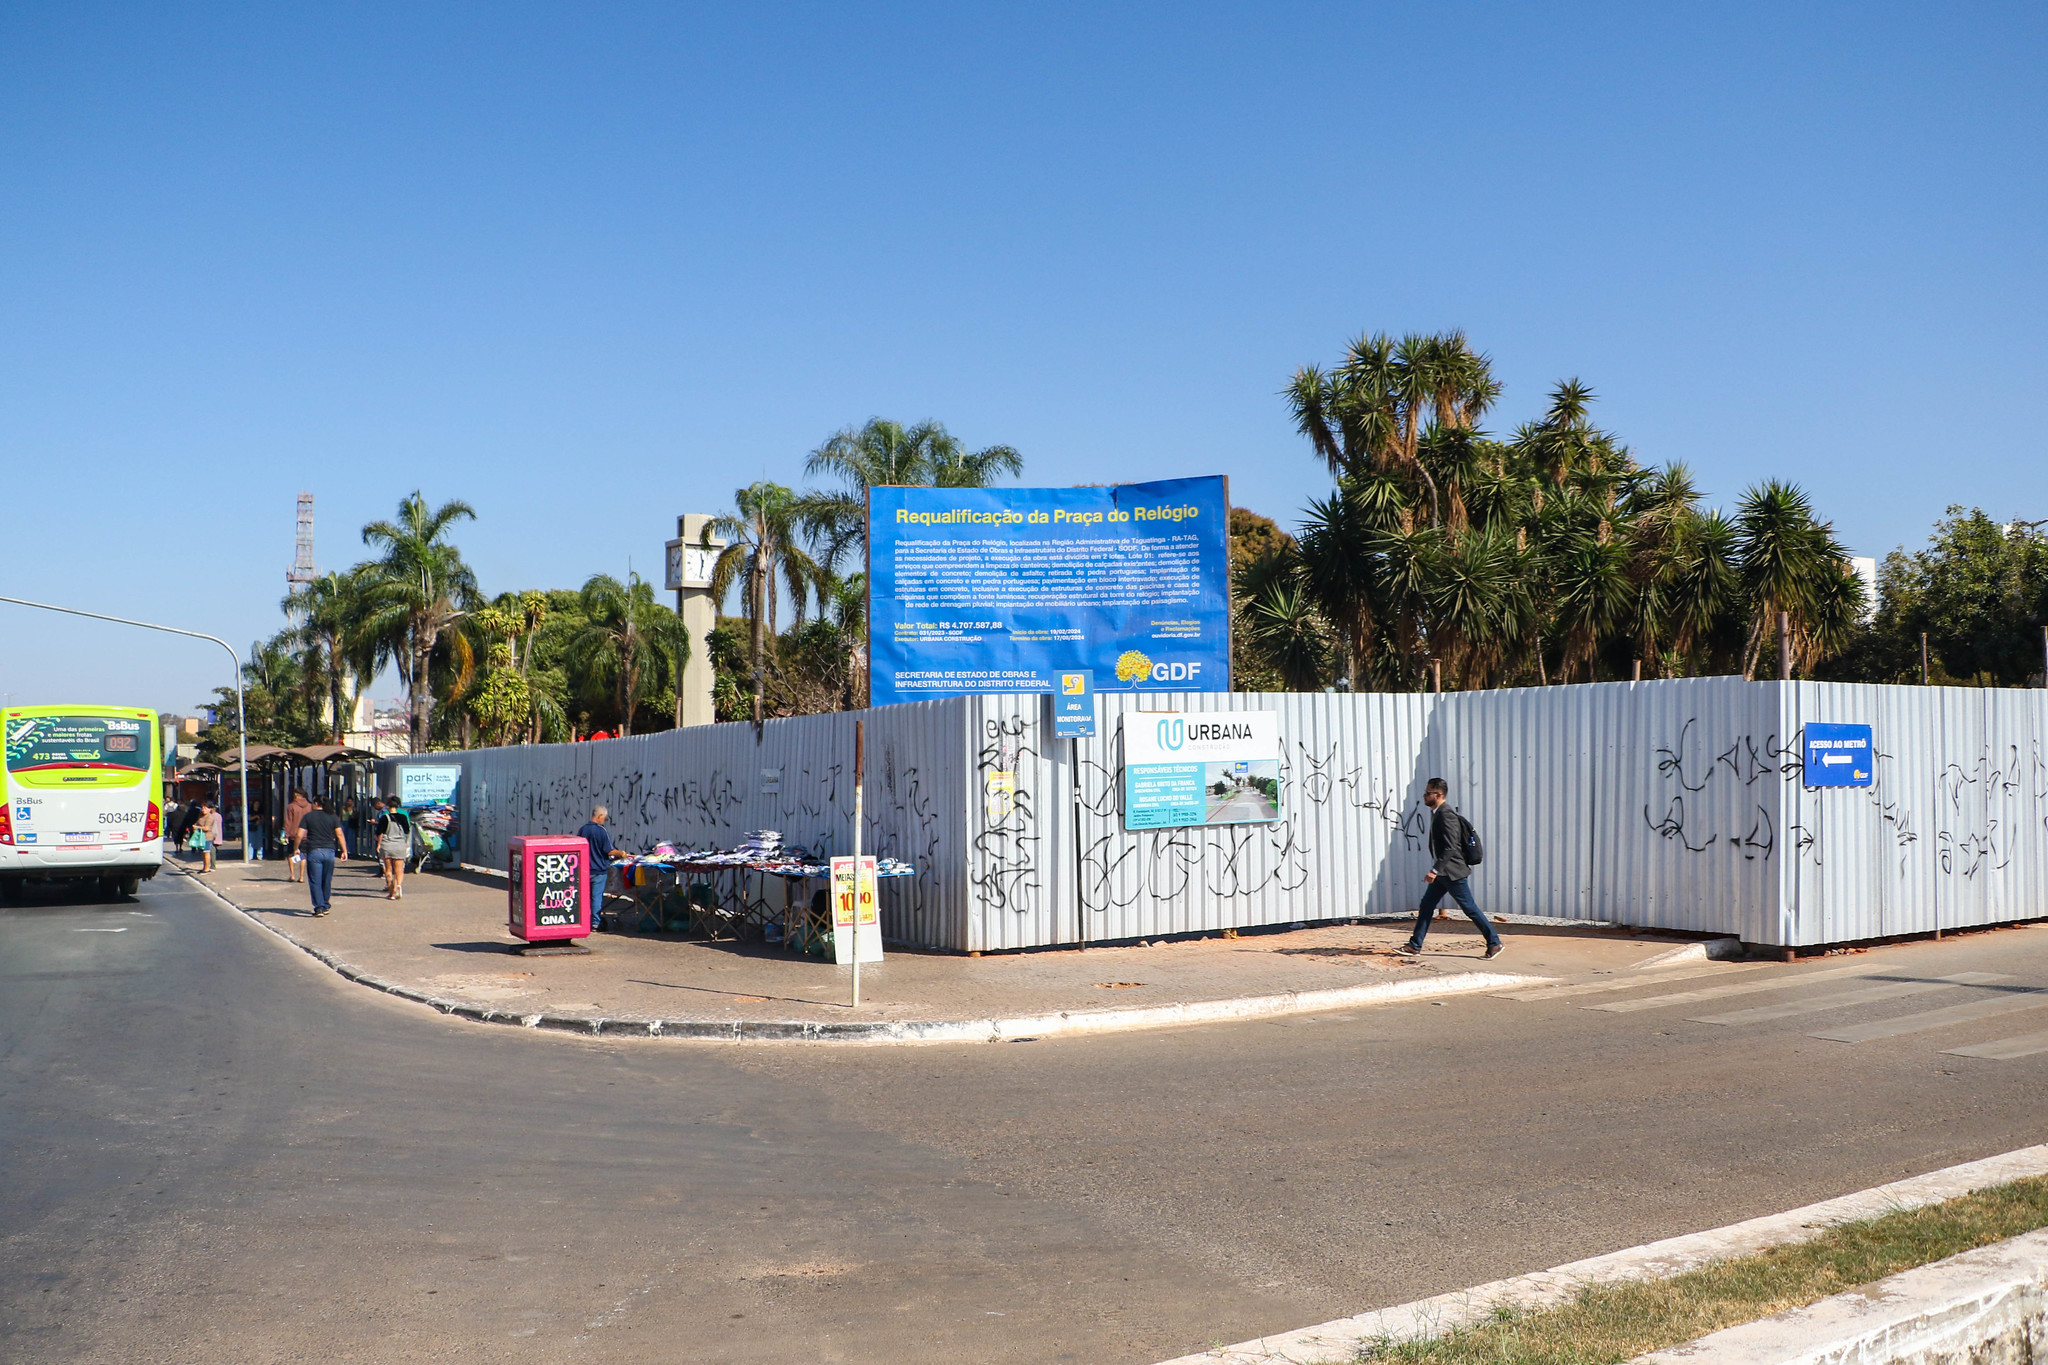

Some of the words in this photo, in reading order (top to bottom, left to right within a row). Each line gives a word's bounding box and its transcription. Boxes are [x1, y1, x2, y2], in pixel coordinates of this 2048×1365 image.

[896, 509, 1023, 527] Requalificação
[1028, 510, 1049, 524] da
[1054, 509, 1103, 527] Praça
[1108, 509, 1129, 522] do
[1134, 504, 1199, 522] Relógio
[939, 621, 950, 629] R$
[951, 621, 1003, 630] 4.707.587,88
[895, 671, 943, 679] SECRETARIA
[945, 671, 956, 679] DE
[957, 671, 988, 679] ESTADO
[1152, 662, 1201, 681] GDF
[895, 680, 963, 688] INFRAESTRUTURA
[978, 679, 1014, 687] DISTRITO
[1015, 679, 1051, 687] FEDERAL
[1066, 702, 1082, 711] ÁREA
[108, 721, 139, 730] BsBus
[1188, 723, 1253, 741] URBANA
[1809, 740, 1832, 749] ACESSO
[1833, 740, 1843, 748] AO
[1843, 738, 1866, 748] METRÔ
[1133, 765, 1172, 775] RESPONSÁVEIS
[1173, 764, 1198, 773] TÉCNICOS
[406, 772, 433, 784] park
[16, 797, 43, 805] BsBus
[98, 812, 145, 824] 503487
[537, 871, 570, 884] SHOP
[541, 915, 566, 925] QNA
[569, 914, 575, 923] 1
